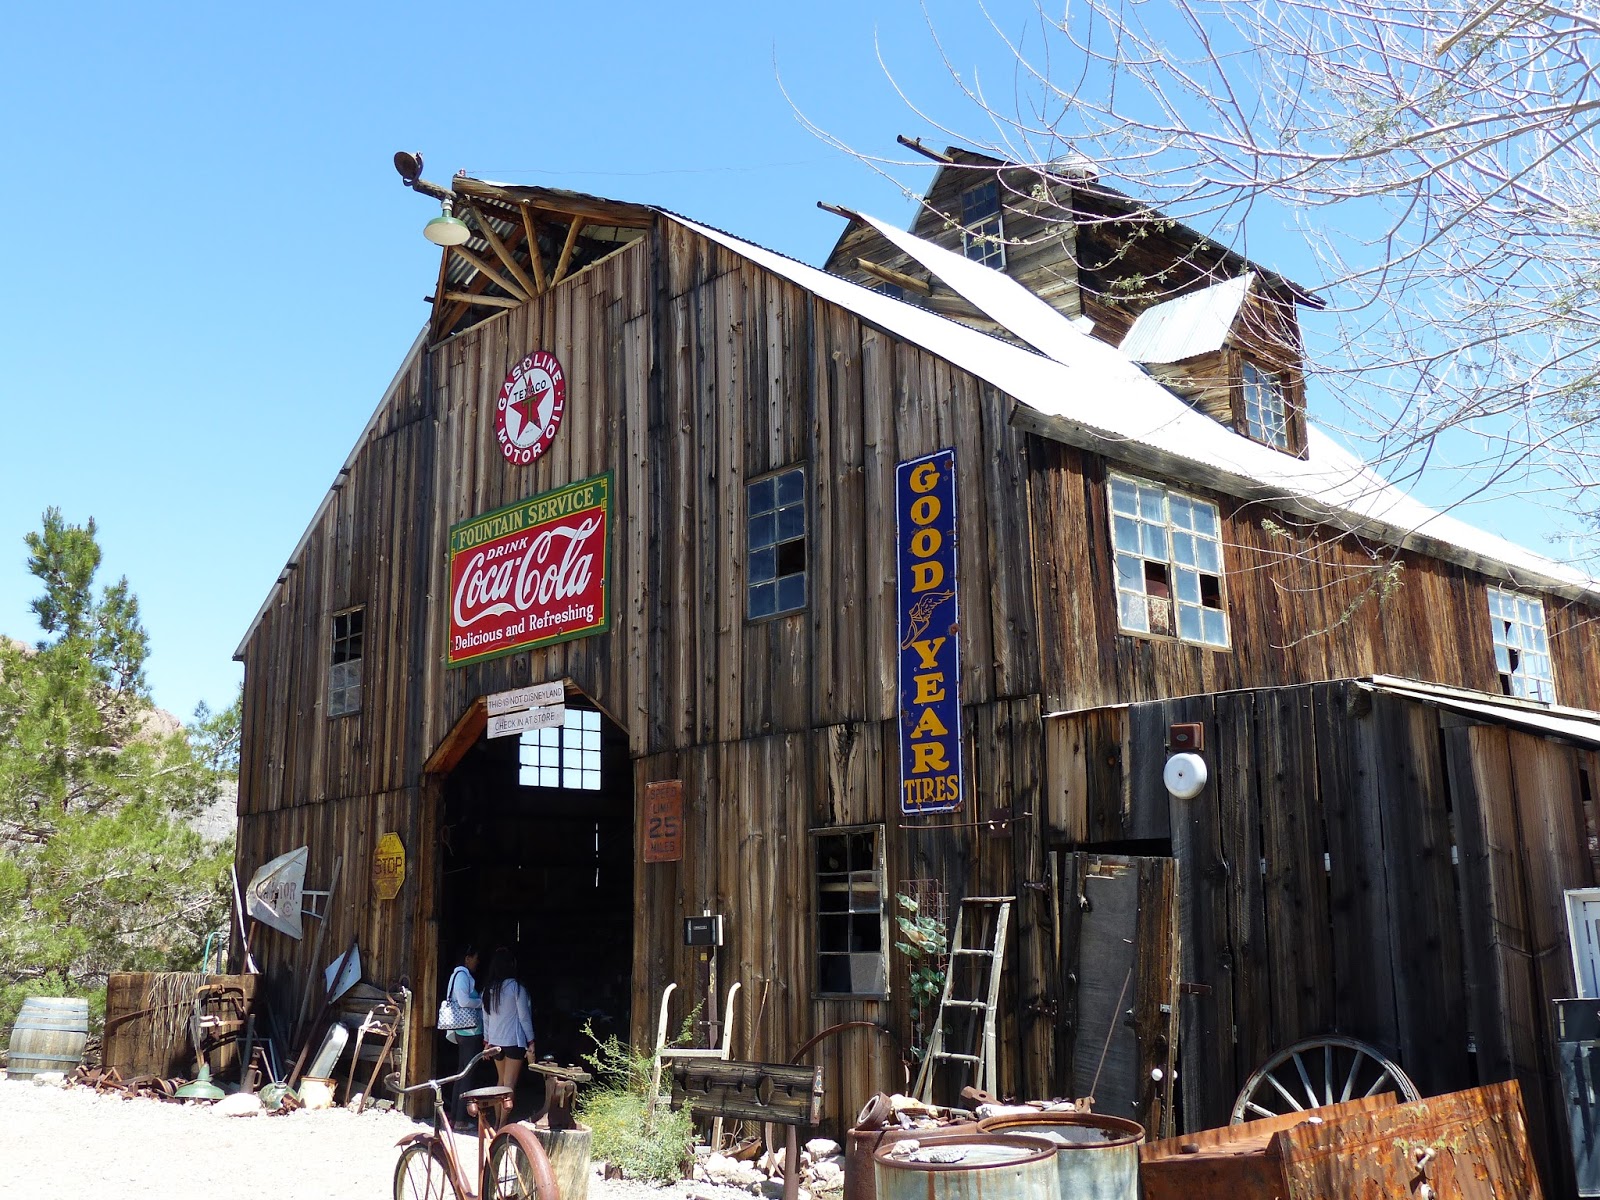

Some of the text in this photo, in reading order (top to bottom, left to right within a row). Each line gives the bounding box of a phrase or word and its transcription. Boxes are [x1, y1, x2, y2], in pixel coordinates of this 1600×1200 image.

[498, 354, 562, 411] GASOLINE
[513, 379, 547, 402] TEXACO
[545, 400, 563, 439] OIL
[498, 427, 542, 463] MOTOR
[459, 486, 594, 549] FOUNTAIN SERVICE
[486, 537, 529, 561] DRINK
[454, 515, 602, 628] Coca-Cola
[455, 604, 594, 651] Delicious and Refreshing
[489, 688, 563, 709] THIS IS NOT DISNEYLAND
[494, 712, 555, 731] CHECK IN AT STORE
[904, 774, 959, 805] TIRES
[649, 815, 678, 838] 25
[374, 856, 403, 875] STOP
